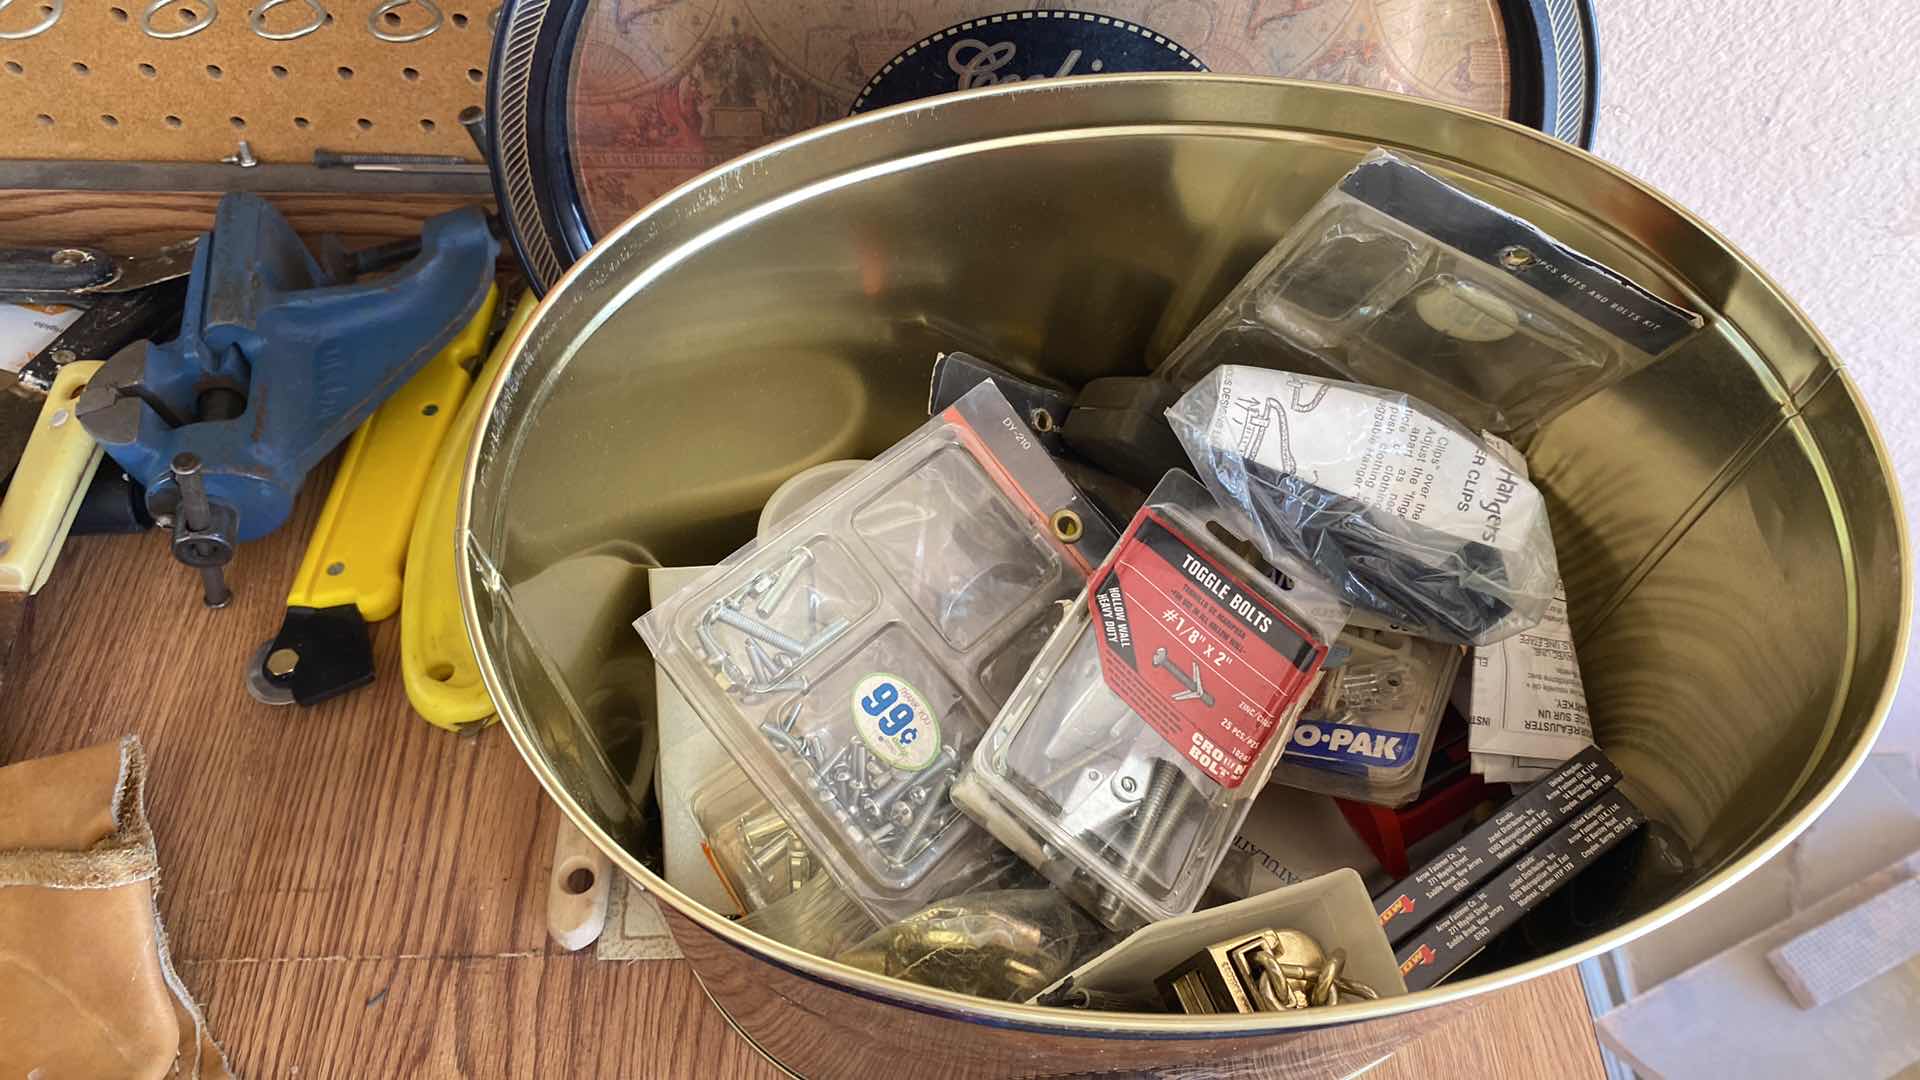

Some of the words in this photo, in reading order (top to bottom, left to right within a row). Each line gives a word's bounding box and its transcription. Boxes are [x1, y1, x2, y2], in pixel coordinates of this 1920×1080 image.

[1559, 272, 1586, 291] NUTS
[1588, 288, 1608, 304] AND
[1609, 301, 1640, 323] BOLTS
[1642, 318, 1661, 331] KIT
[1001, 416, 1032, 451] DY-210
[1403, 426, 1421, 458] apart
[1415, 426, 1437, 464] Adjust
[1394, 468, 1407, 482] as
[1408, 466, 1424, 485] the
[1418, 473, 1434, 499] over
[1456, 468, 1480, 513] CLIPS
[1410, 502, 1425, 521] the
[1479, 466, 1521, 544] Hangers
[1096, 592, 1113, 617] HEAVY
[1108, 586, 1126, 620] HOLLOW
[1179, 553, 1231, 600] TOGGLE
[1227, 594, 1274, 634] BOLTS
[1104, 620, 1118, 642] DUTY
[1116, 623, 1131, 648] WALL
[1160, 606, 1206, 644] #1/8"
[1212, 650, 1233, 666] 2"
[1219, 717, 1233, 730] 25
[1537, 709, 1550, 718] UN
[1552, 710, 1571, 721] SUR
[1558, 775, 1577, 791] Fastener
[1569, 815, 1585, 830] United
[1583, 802, 1604, 820] Kingdom
[1579, 817, 1599, 835] Fastener
[1604, 816, 1617, 828] Road
[1414, 870, 1430, 883] Arrow
[1428, 856, 1448, 873] Fastener
[1453, 854, 1468, 867] Street
[1456, 866, 1468, 876] New
[1467, 856, 1483, 870] Jersey
[1557, 853, 1569, 864] East
[1435, 917, 1451, 932] Arrow
[1449, 904, 1469, 921] Fastener
[1448, 925, 1458, 935] 271
[1473, 902, 1489, 916] Street
[1477, 914, 1489, 925] New
[1487, 904, 1504, 919] Jersey
